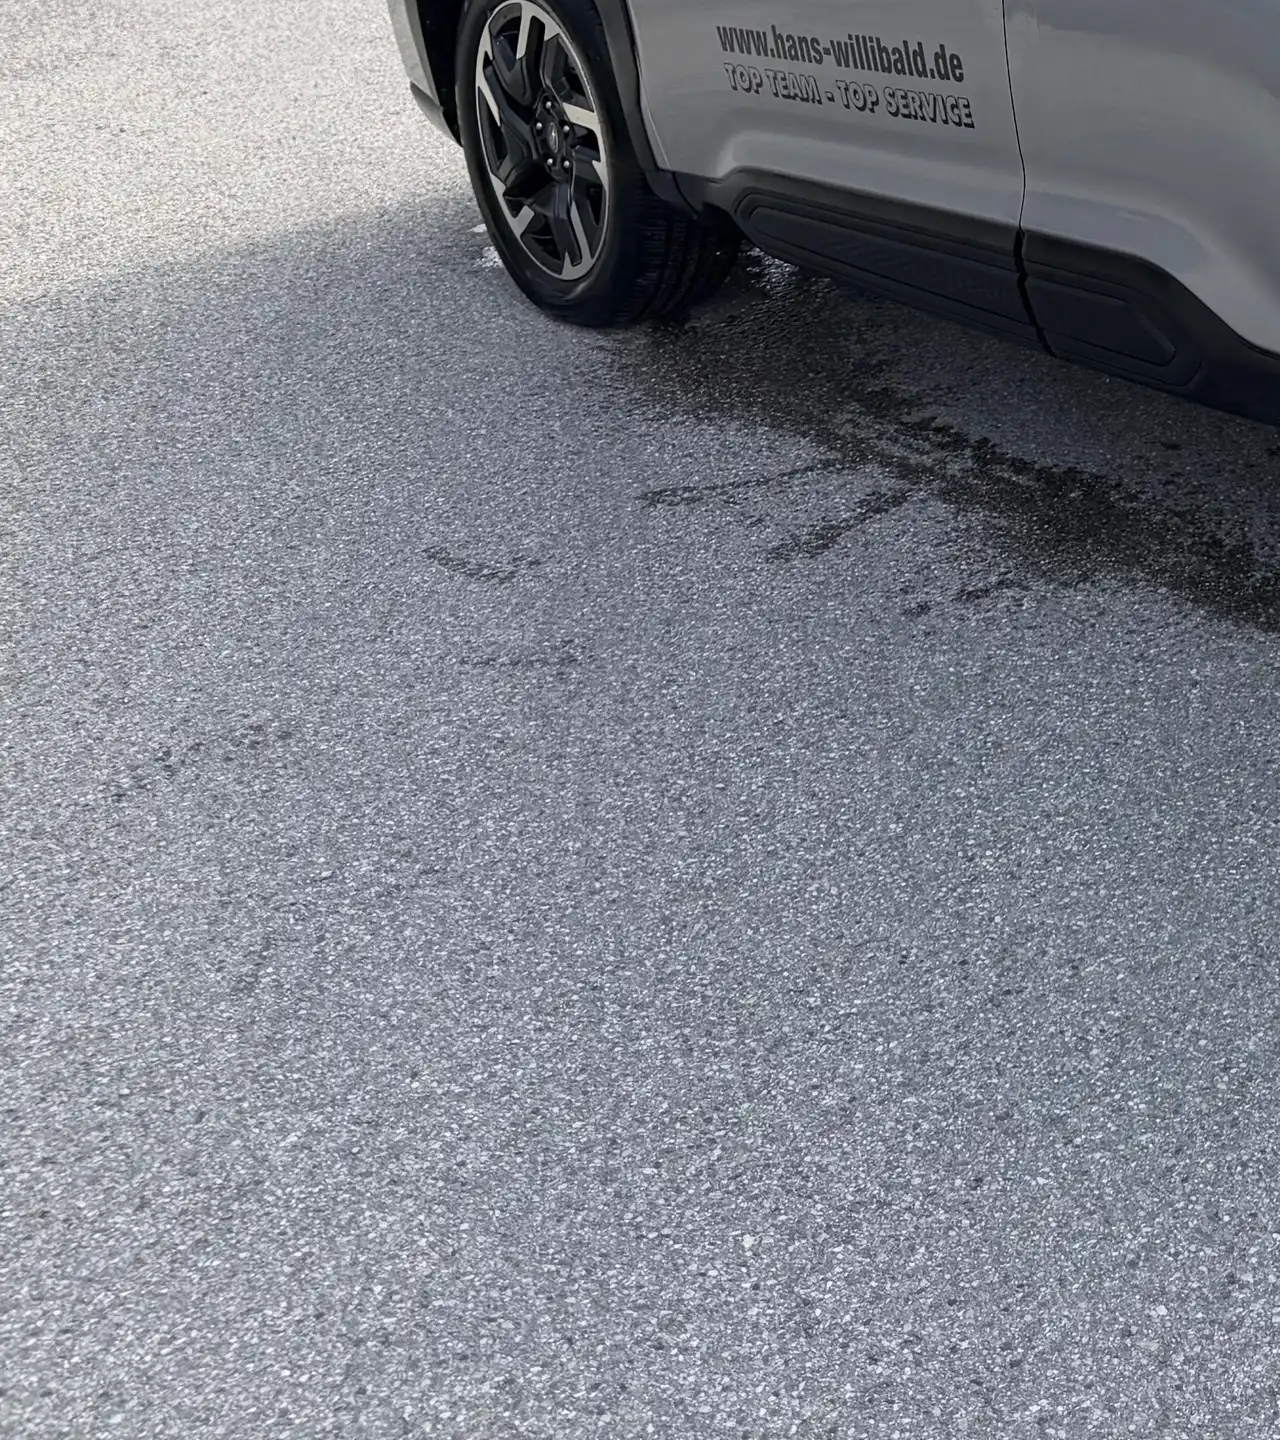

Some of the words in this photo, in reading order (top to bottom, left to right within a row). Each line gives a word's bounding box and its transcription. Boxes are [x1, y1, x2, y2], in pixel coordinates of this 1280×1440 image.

[716, 24, 964, 83] www.hans-willibald.de
[724, 62, 764, 95] TOP
[765, 67, 823, 106] TEAM
[836, 79, 880, 113] TOP
[884, 84, 976, 130] SERVICE
